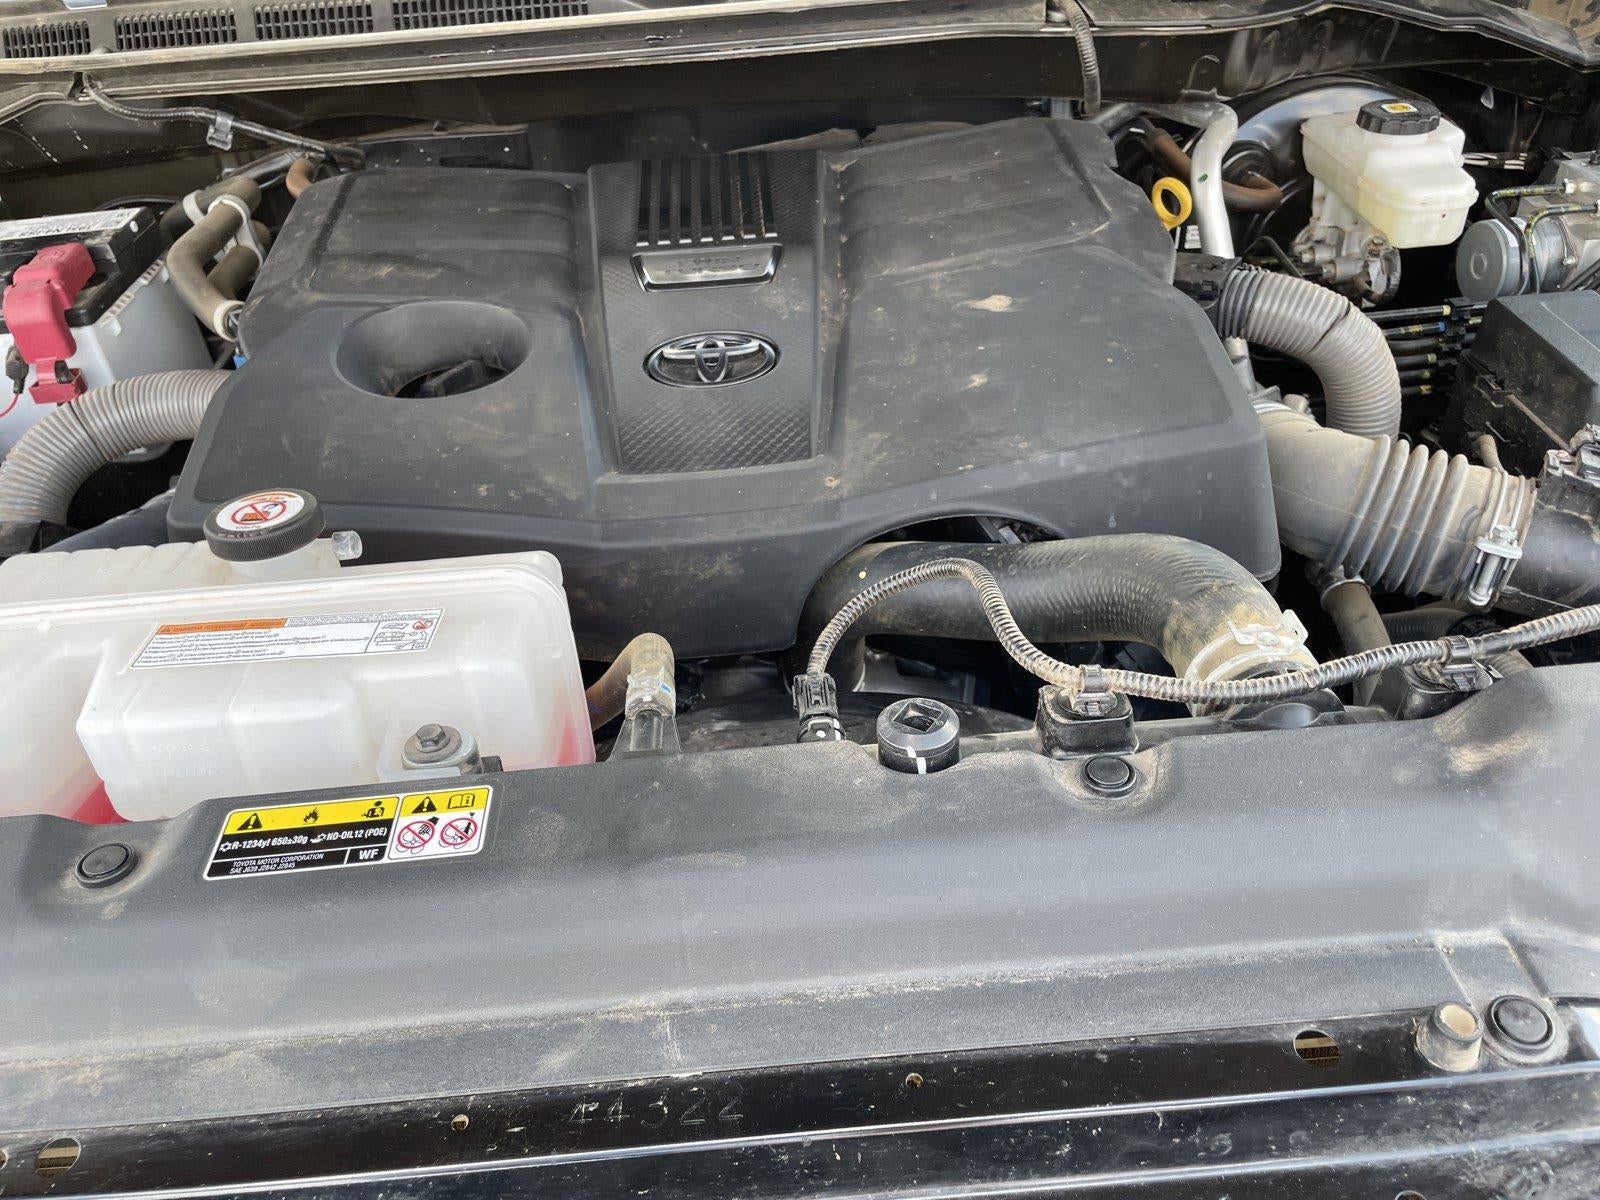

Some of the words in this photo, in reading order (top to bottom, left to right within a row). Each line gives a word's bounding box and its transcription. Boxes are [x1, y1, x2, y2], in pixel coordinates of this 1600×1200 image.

[271, 834, 308, 847] 650±30g
[365, 827, 388, 839] (POE)
[233, 859, 256, 868] TOYOTA
[257, 857, 280, 866] MOTOR
[280, 853, 324, 863] CORPORATION
[359, 848, 379, 860] WF
[229, 867, 241, 875] SAE
